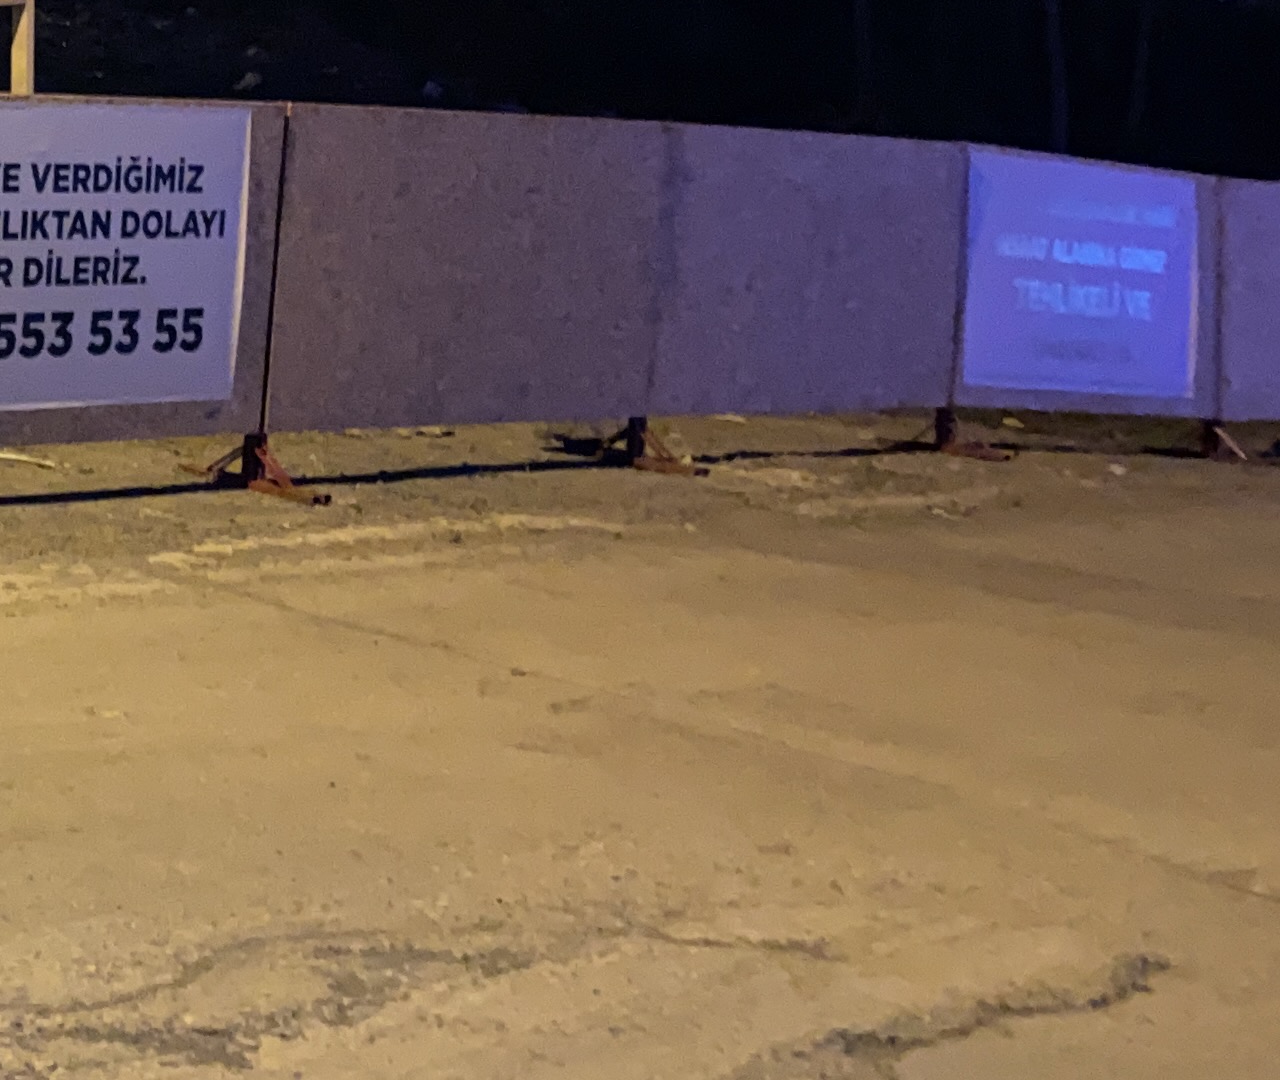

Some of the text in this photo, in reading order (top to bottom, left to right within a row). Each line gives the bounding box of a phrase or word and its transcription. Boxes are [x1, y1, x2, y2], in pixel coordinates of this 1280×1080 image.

[31, 155, 205, 194] VERDİĞİMİZ
[120, 209, 226, 240] DOLAYI
[23, 248, 147, 287] DİLERİZ.
[86, 310, 140, 356] 53
[152, 308, 205, 353] 55
